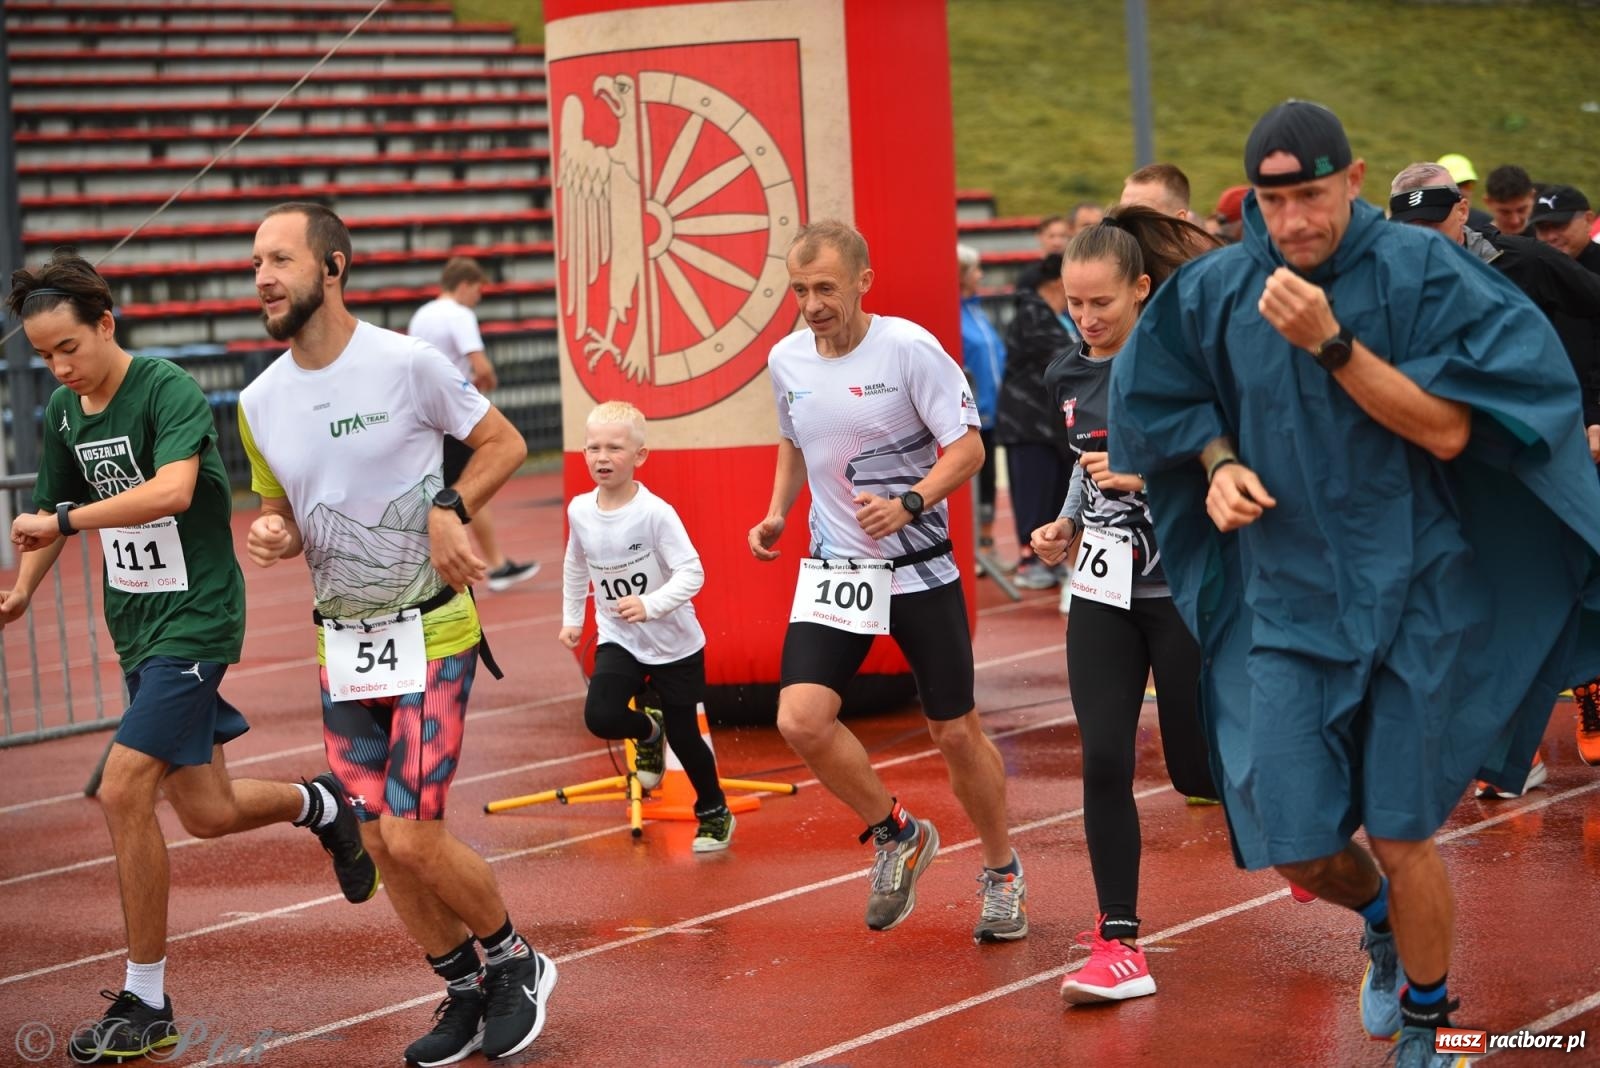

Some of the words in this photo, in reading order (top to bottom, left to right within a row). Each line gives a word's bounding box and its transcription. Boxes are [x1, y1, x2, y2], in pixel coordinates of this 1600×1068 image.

[864, 382, 886, 391] SILESIA
[864, 386, 899, 397] MARATHON
[330, 411, 368, 438] UTA
[366, 414, 386, 423] TEAM
[81, 443, 127, 461] KOSZALIN
[112, 539, 167, 571] 111
[1078, 541, 1109, 578] 76
[600, 572, 648, 600] 109
[814, 579, 874, 611] 100
[355, 638, 399, 673] 54
[350, 682, 388, 693] Racibórz
